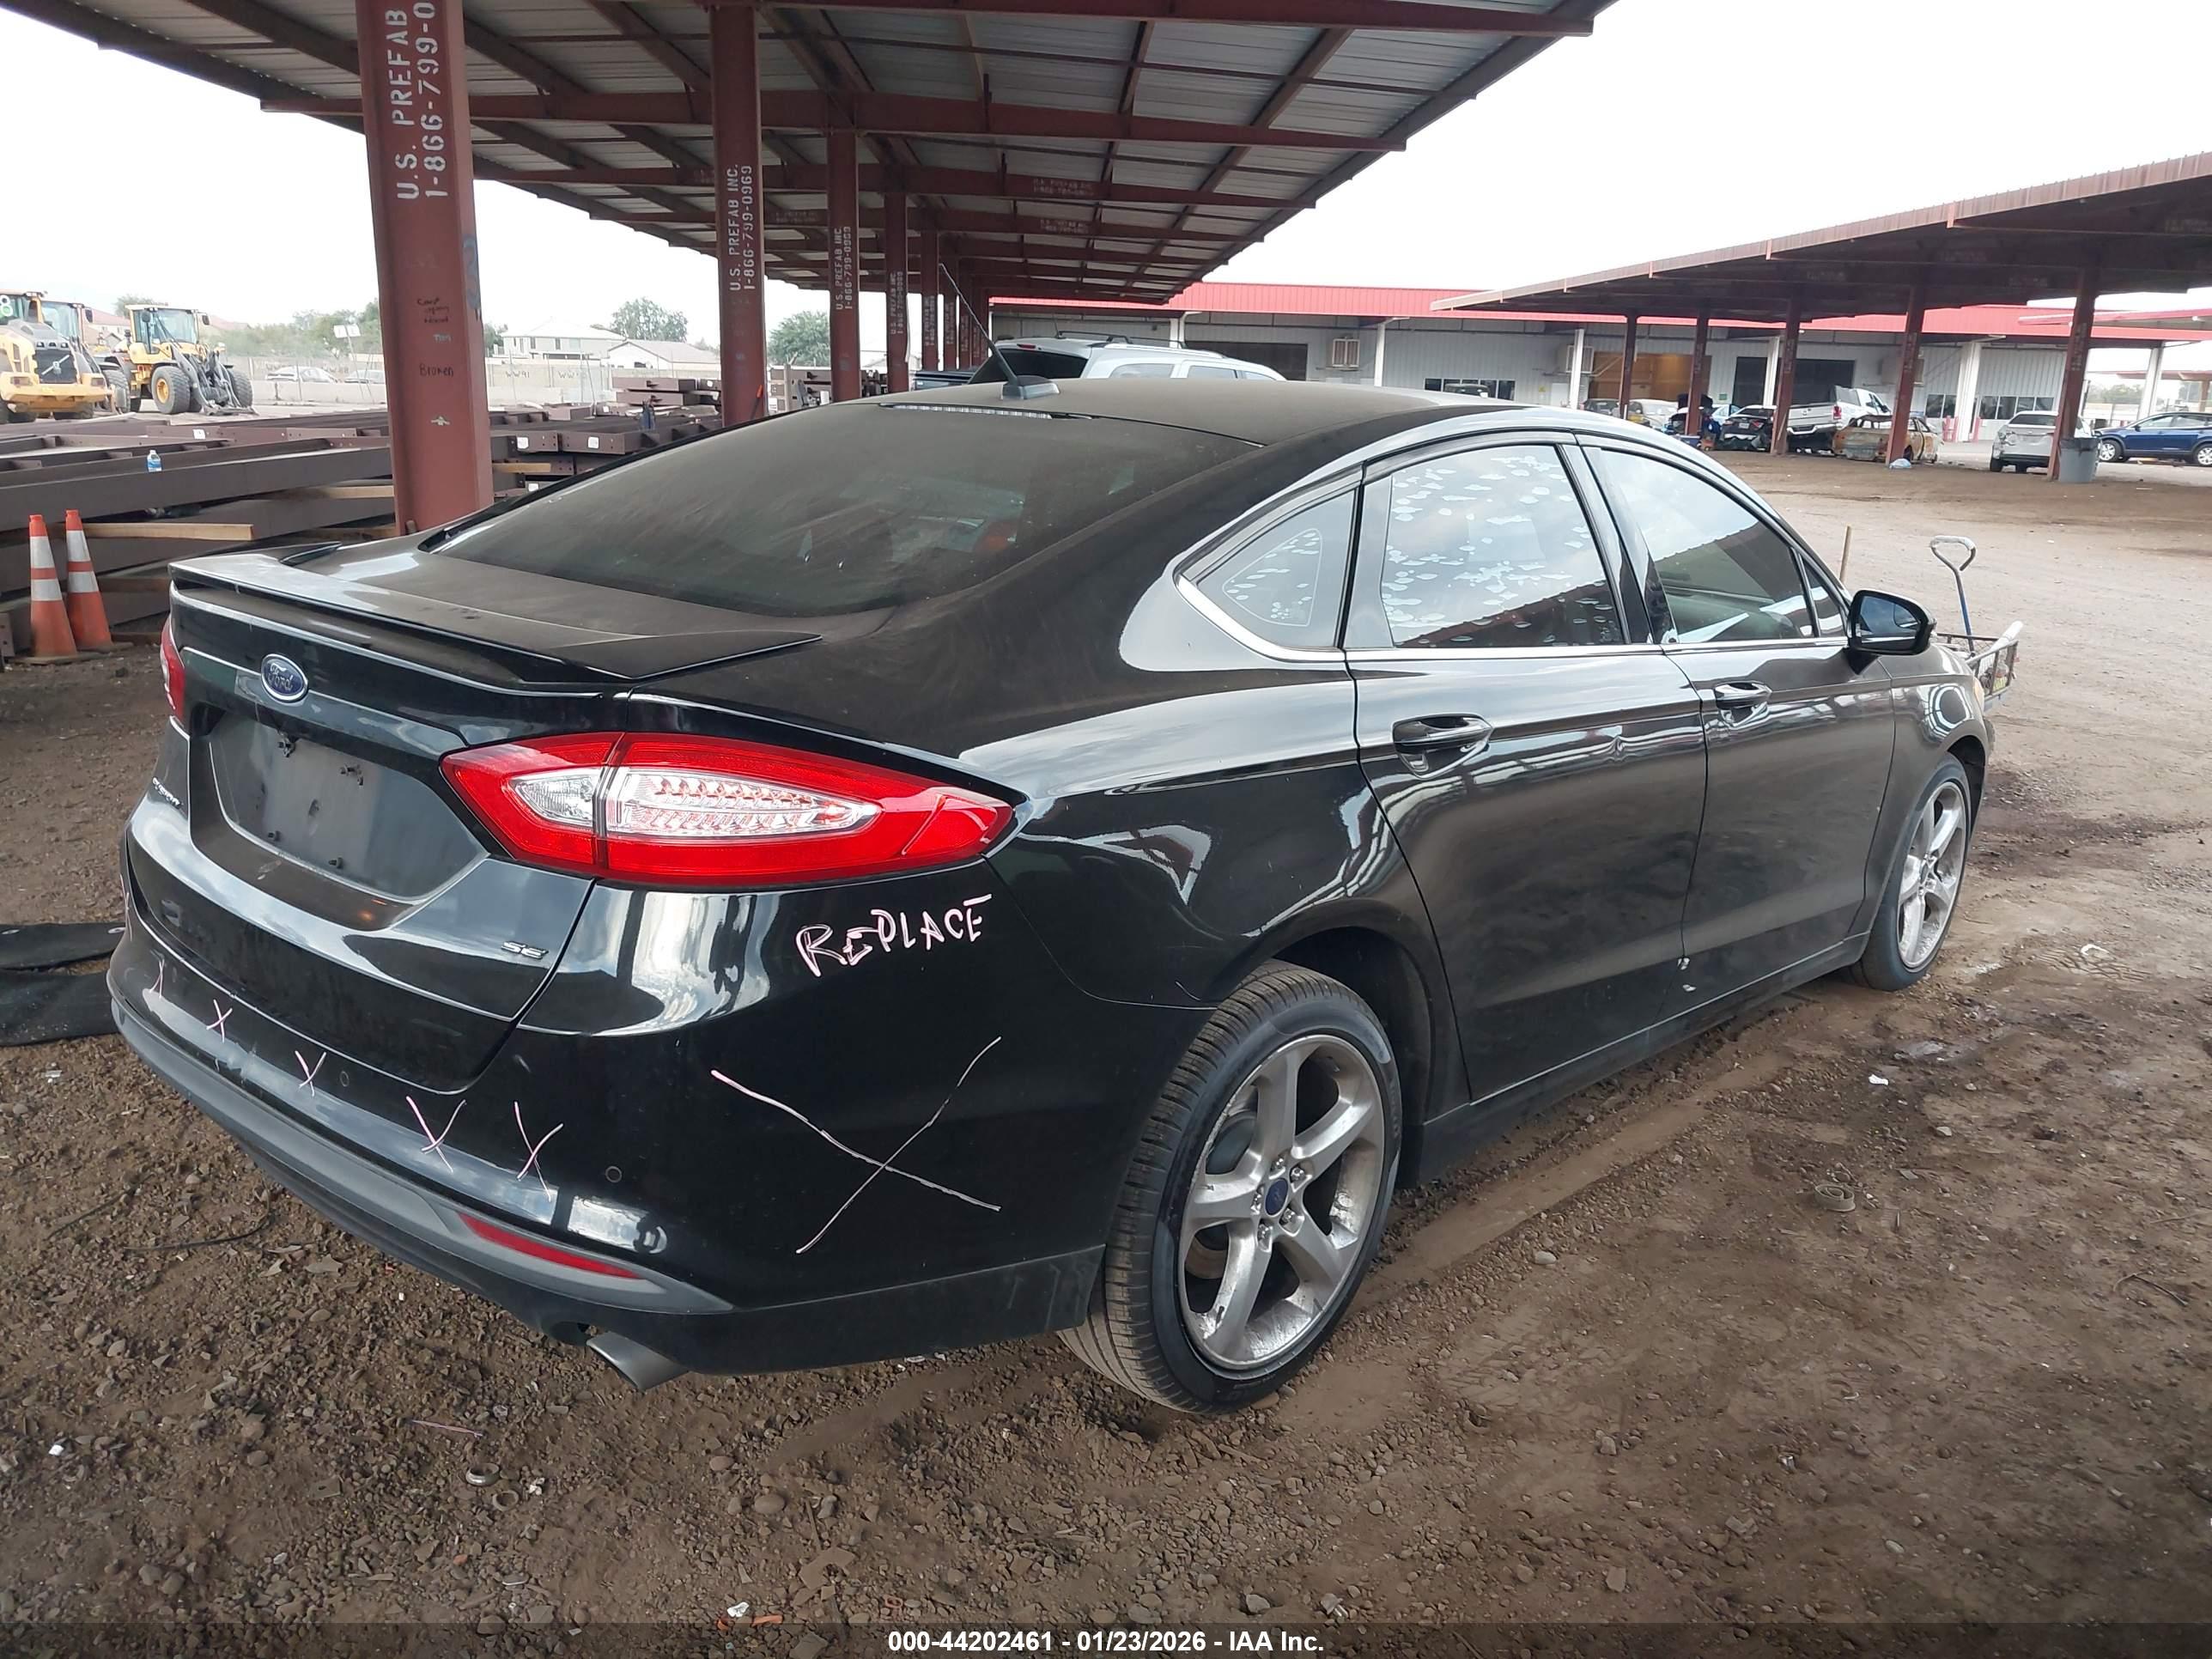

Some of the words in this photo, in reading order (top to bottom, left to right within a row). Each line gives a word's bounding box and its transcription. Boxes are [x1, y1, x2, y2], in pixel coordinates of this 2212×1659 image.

[386, 9, 415, 126] PREFAB
[413, 3, 448, 198] 1-866-799-0
[395, 144, 420, 199] U.S.
[726, 164, 738, 191] INC.
[727, 199, 740, 255] PREFAB
[741, 165, 756, 290] 1-866-799-0969
[729, 263, 741, 291] U.S.
[418, 363, 454, 377] Broken
[267, 662, 295, 691] Ford
[501, 941, 547, 959] SE
[795, 893, 993, 977] REPLACE
